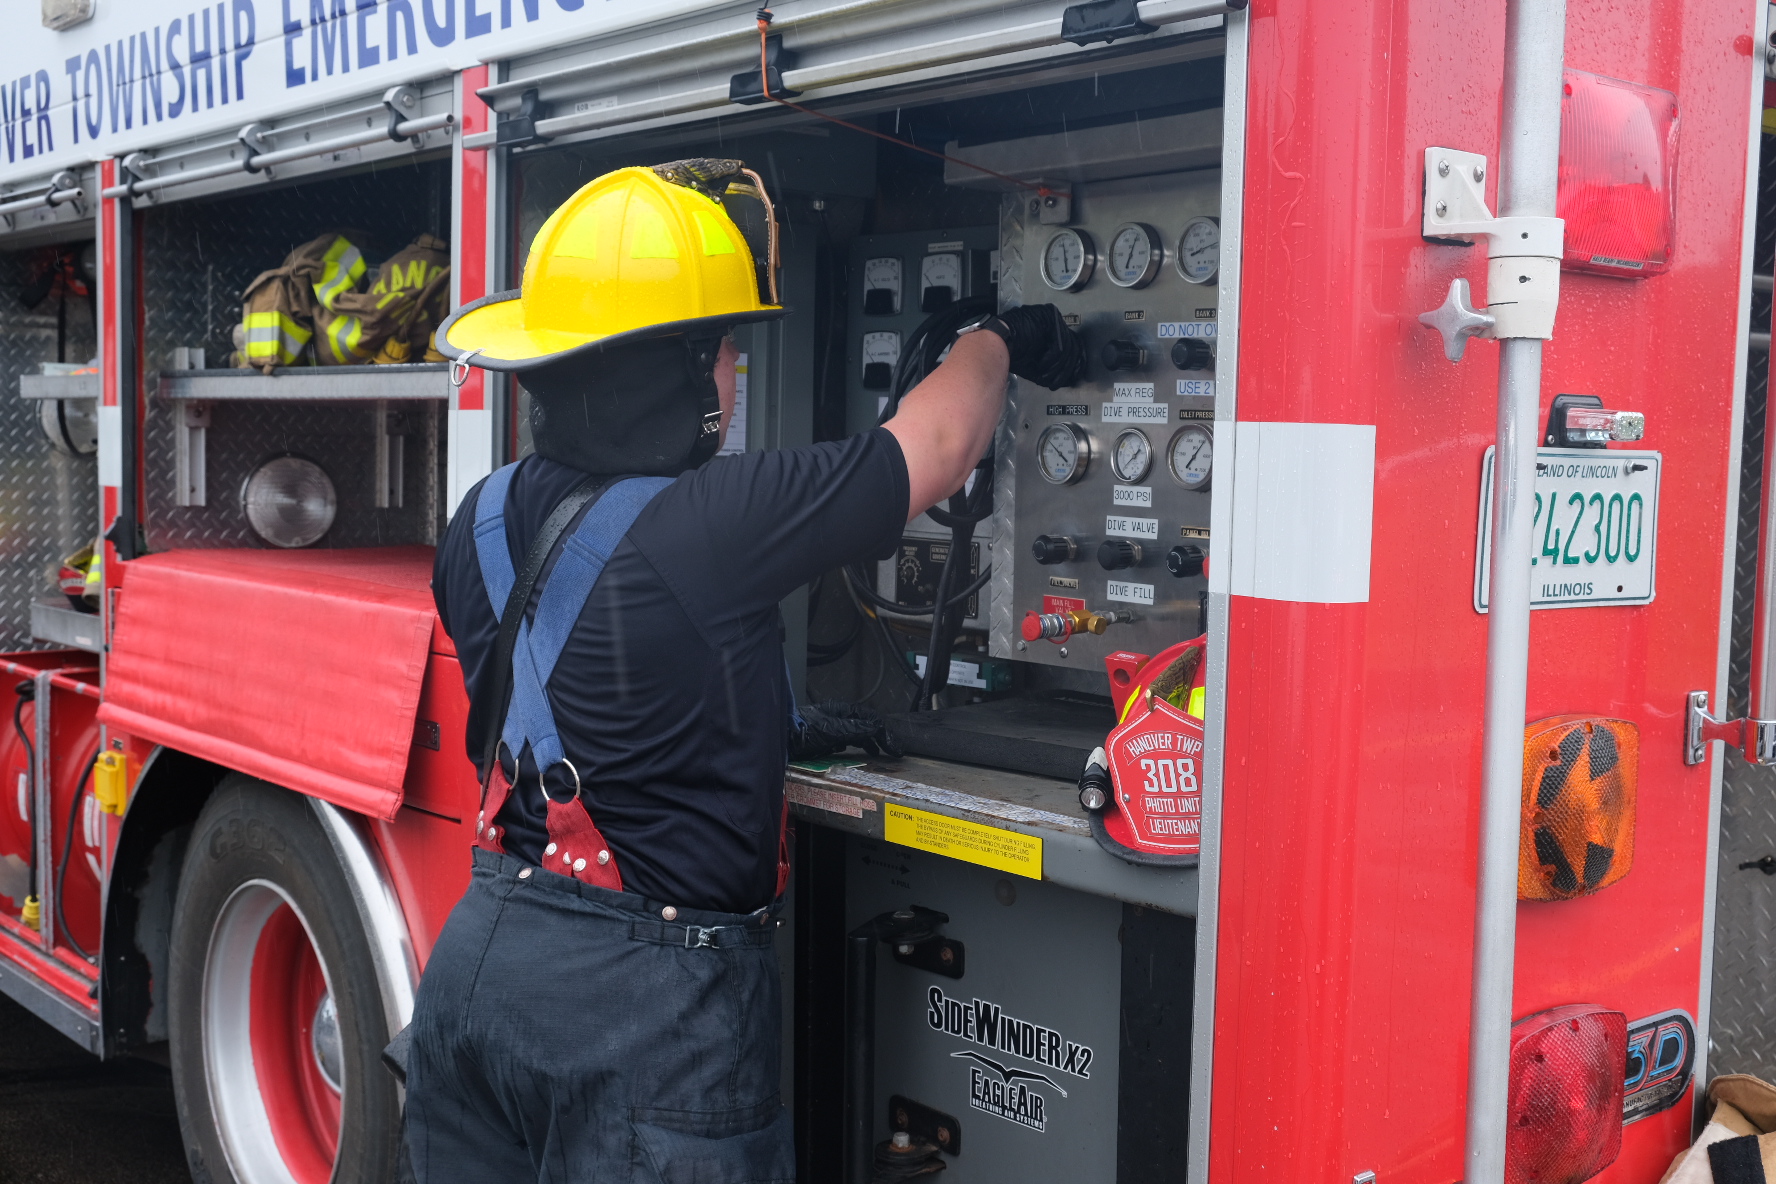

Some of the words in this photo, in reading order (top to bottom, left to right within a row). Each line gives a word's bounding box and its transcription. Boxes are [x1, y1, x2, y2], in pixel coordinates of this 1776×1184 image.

[65, 0, 255, 145] TOWNSHIP
[1160, 324, 1176, 337] DO
[1178, 324, 1202, 336] NOT
[1113, 387, 1132, 398] MAX
[1135, 387, 1154, 398] REG
[1179, 382, 1201, 394] USE
[1204, 382, 1210, 394] 2
[1066, 406, 1086, 415] PRESS
[1103, 406, 1122, 417] DIVE
[1127, 406, 1167, 418] PRESSURE
[1537, 464, 1564, 478] LAND
[1566, 465, 1580, 478] OF
[1581, 465, 1618, 479] LINCOLN
[1115, 490, 1134, 500] 3000
[1137, 491, 1151, 502] PSI
[1108, 519, 1126, 531] DIVE
[1132, 521, 1156, 534] VALVE
[1110, 584, 1128, 596] DIVE
[1134, 587, 1154, 600] FILL
[1542, 582, 1593, 598] ILLINOIS
[1126, 733, 1172, 757] HANOVER
[1177, 735, 1202, 755] TWP
[1140, 758, 1198, 793] 308
[1145, 797, 1175, 813] PHOTO
[1178, 798, 1200, 813] UNIT
[890, 810, 914, 822] CAUTION:
[1062, 1040, 1093, 1079] X2
[972, 1098, 1003, 1115] BREATHING
[1004, 1109, 1014, 1119] AIR
[1016, 1114, 1043, 1130] SYSTEMS
